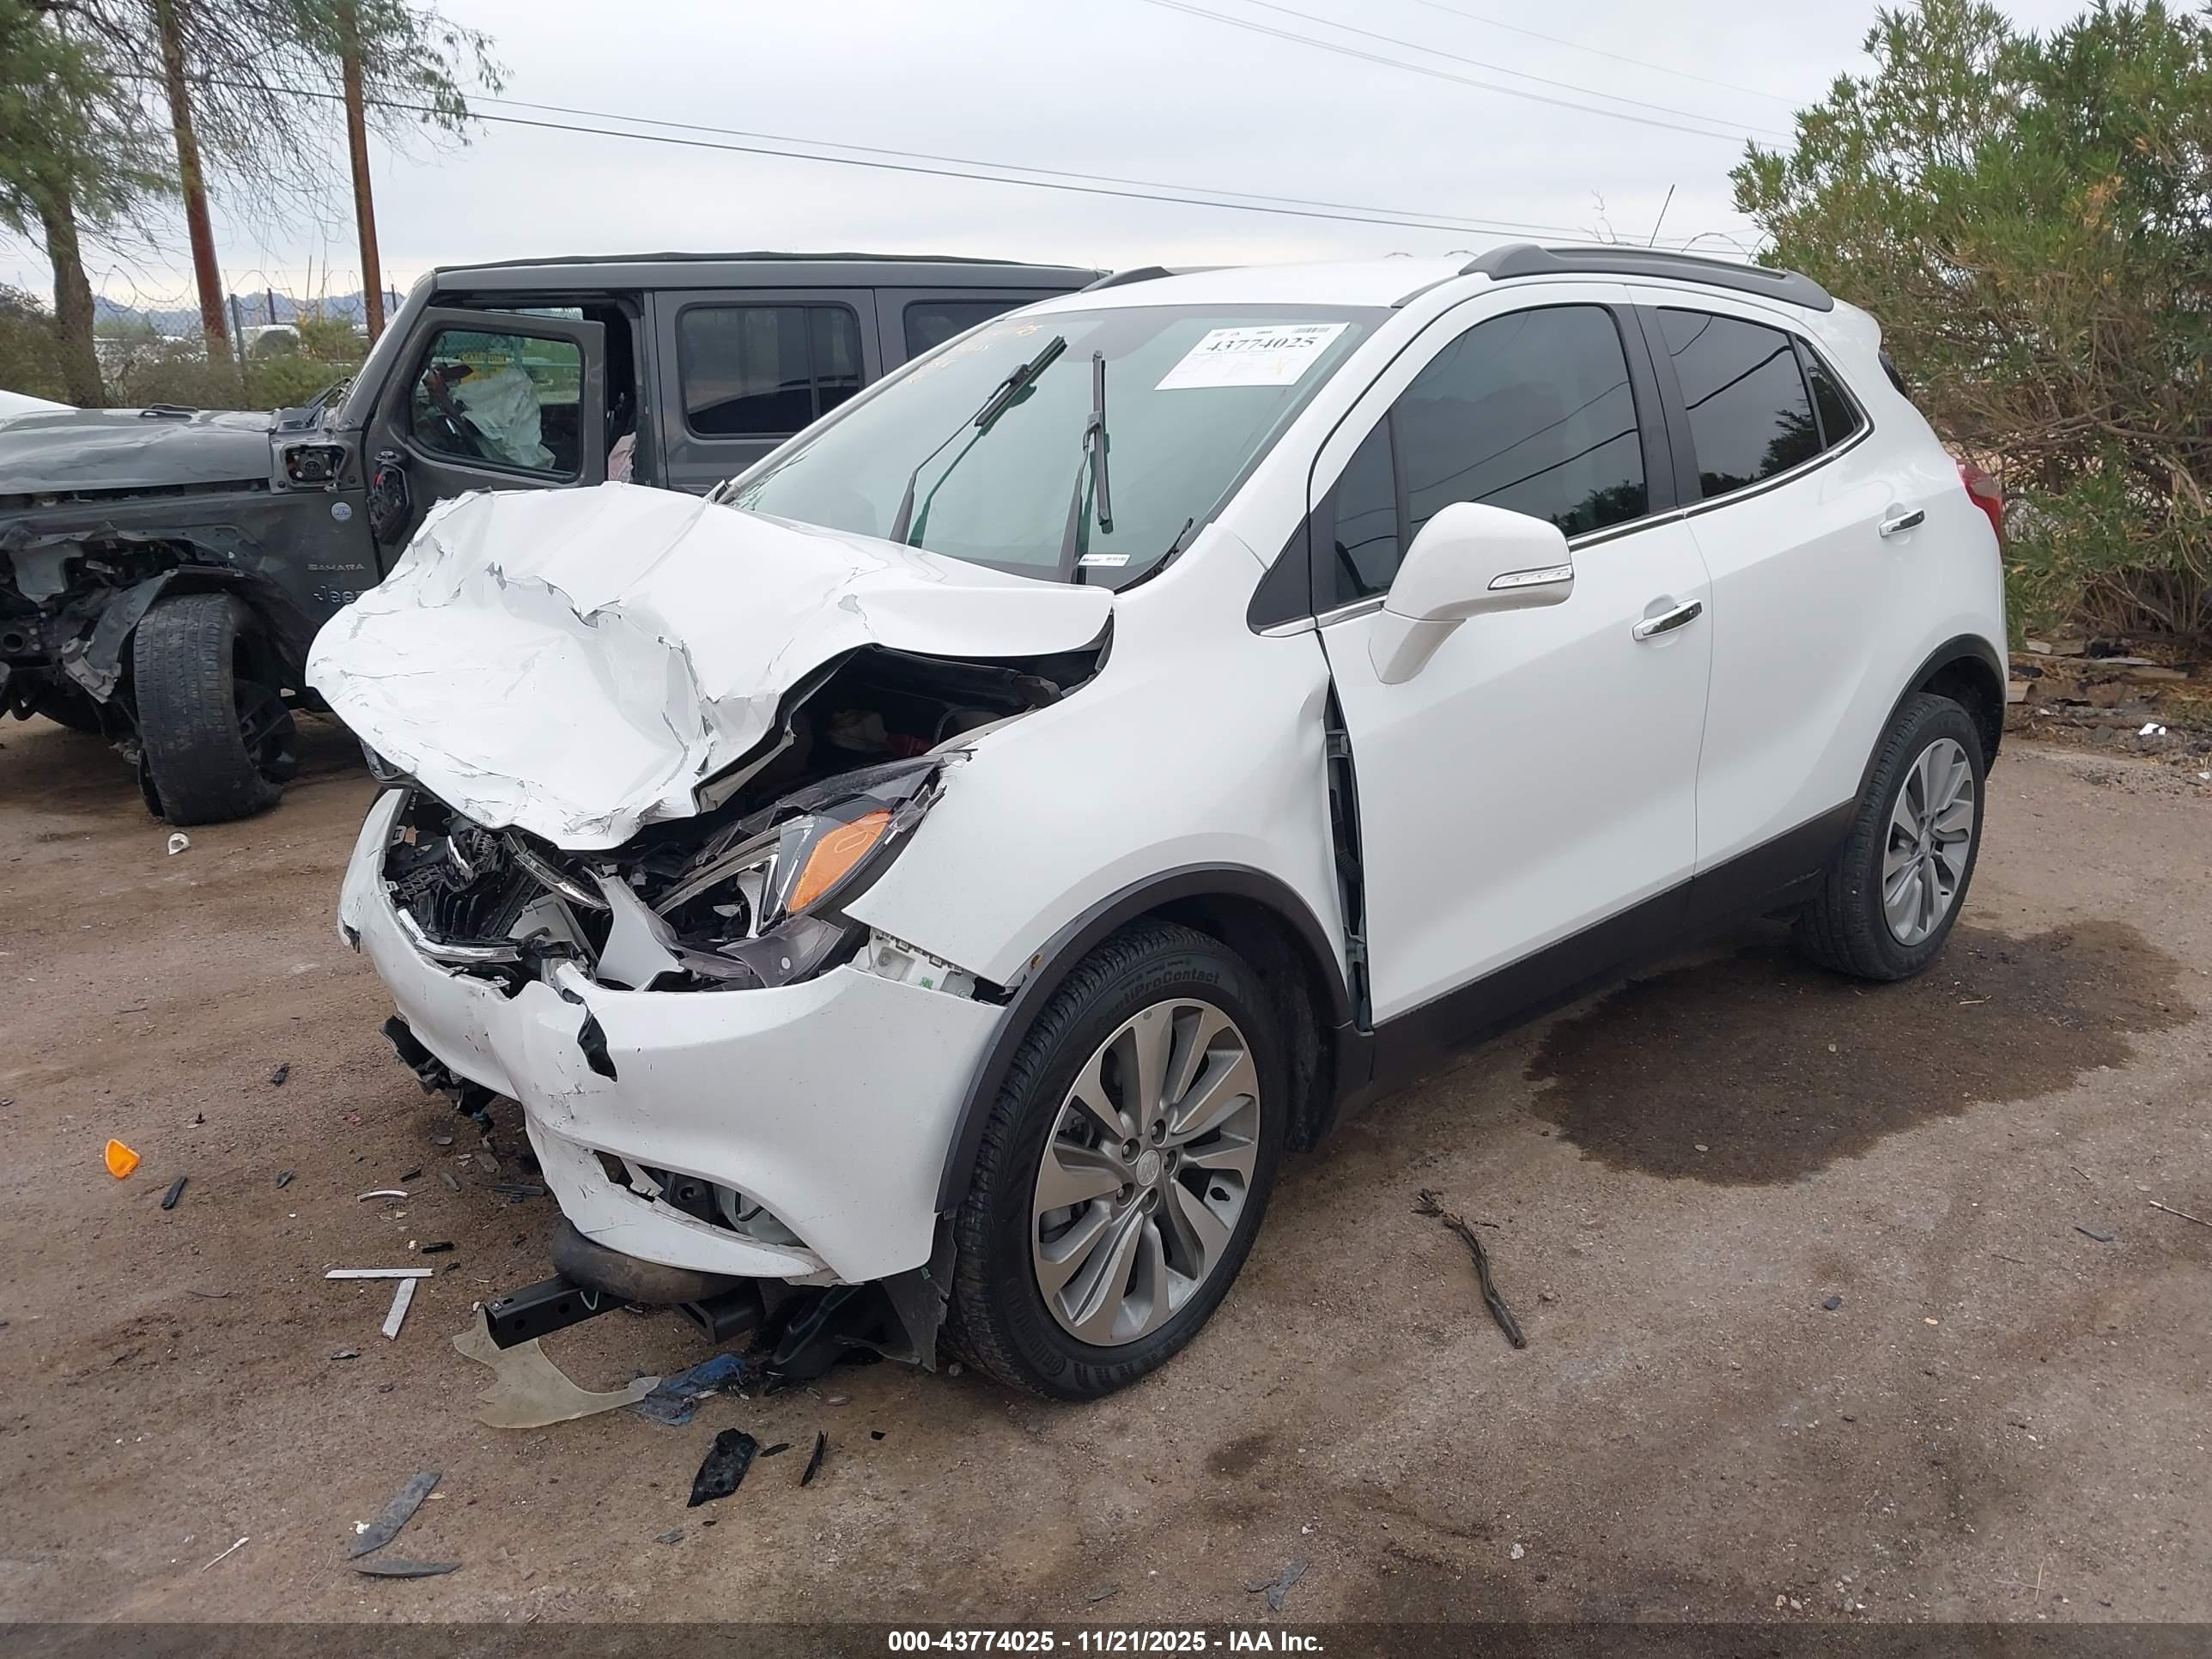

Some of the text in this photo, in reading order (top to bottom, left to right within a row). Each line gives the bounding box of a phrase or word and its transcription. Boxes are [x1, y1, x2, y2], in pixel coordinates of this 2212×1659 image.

[1206, 337, 1318, 351] 43774025
[307, 562, 365, 571] SAHARA
[313, 585, 366, 603] Jee
